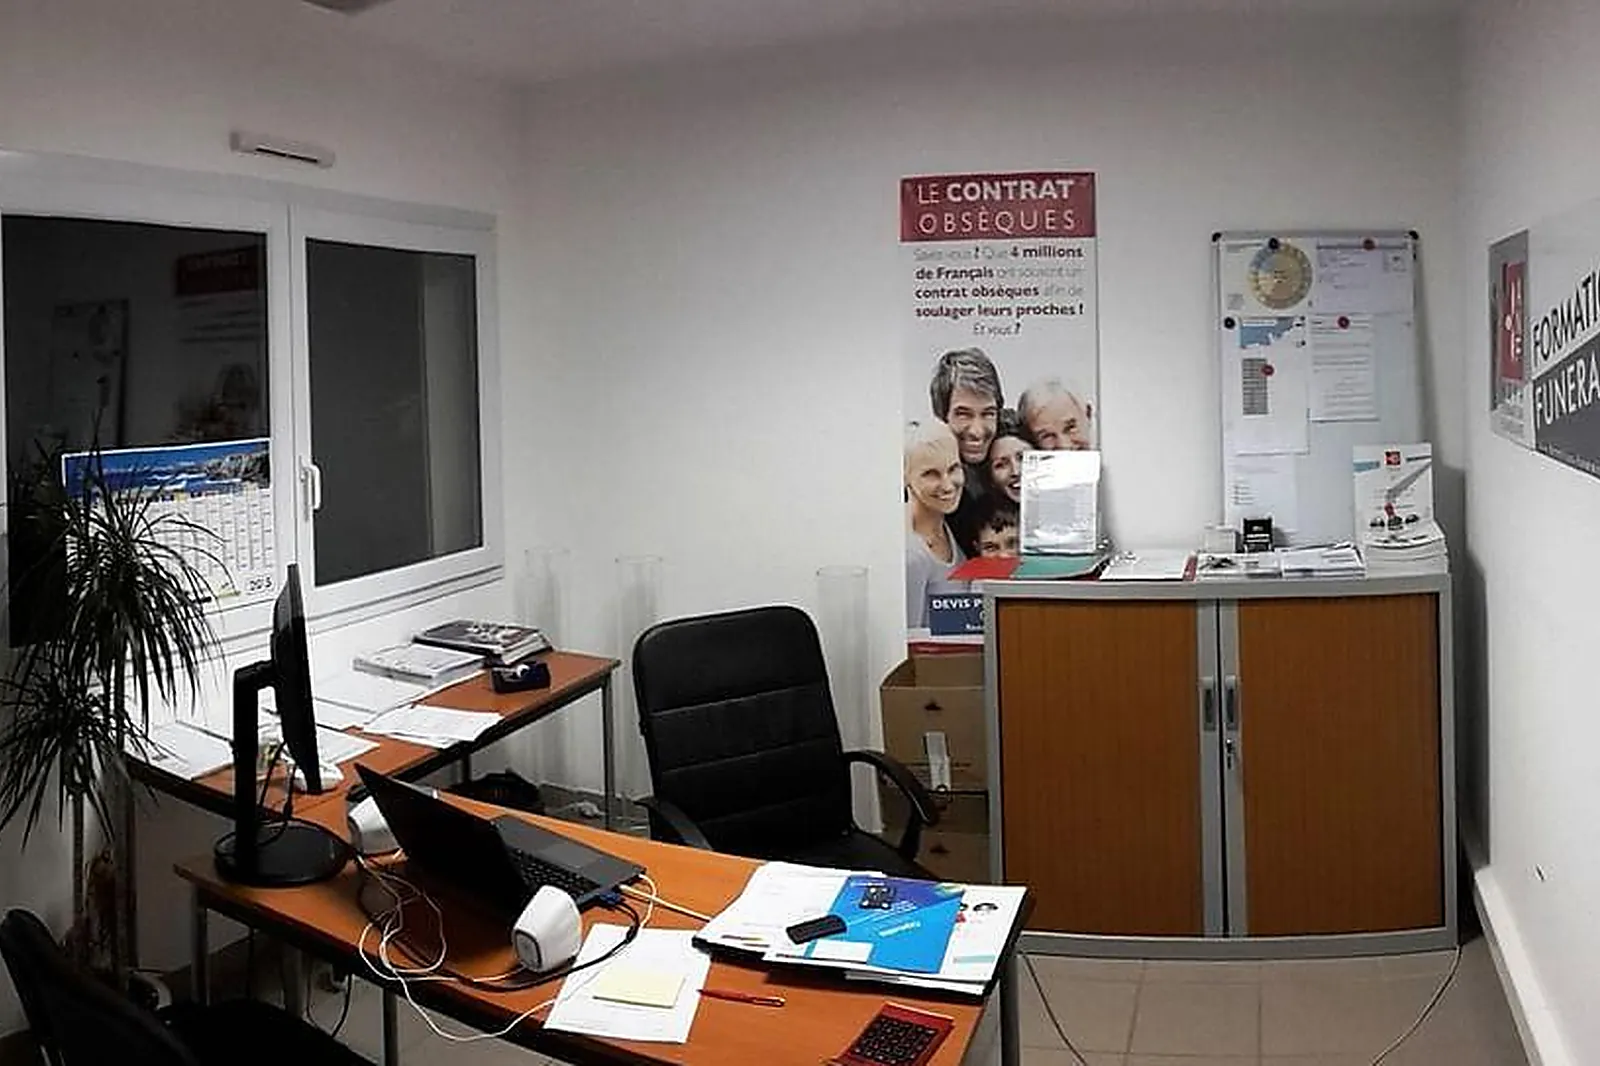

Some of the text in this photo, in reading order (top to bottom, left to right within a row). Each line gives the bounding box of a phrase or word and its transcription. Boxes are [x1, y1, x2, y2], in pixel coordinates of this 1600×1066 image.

[917, 179, 1074, 204] LE CONTRAT
[918, 206, 1075, 235] OBSÈQUES
[1023, 245, 1084, 258] millions
[915, 267, 934, 280] de
[936, 266, 994, 281] Français
[915, 287, 968, 300] contrat
[915, 305, 974, 320] soulager
[977, 304, 1013, 317] leurs
[1016, 302, 1076, 318] proches
[931, 598, 971, 610] DEVIS
